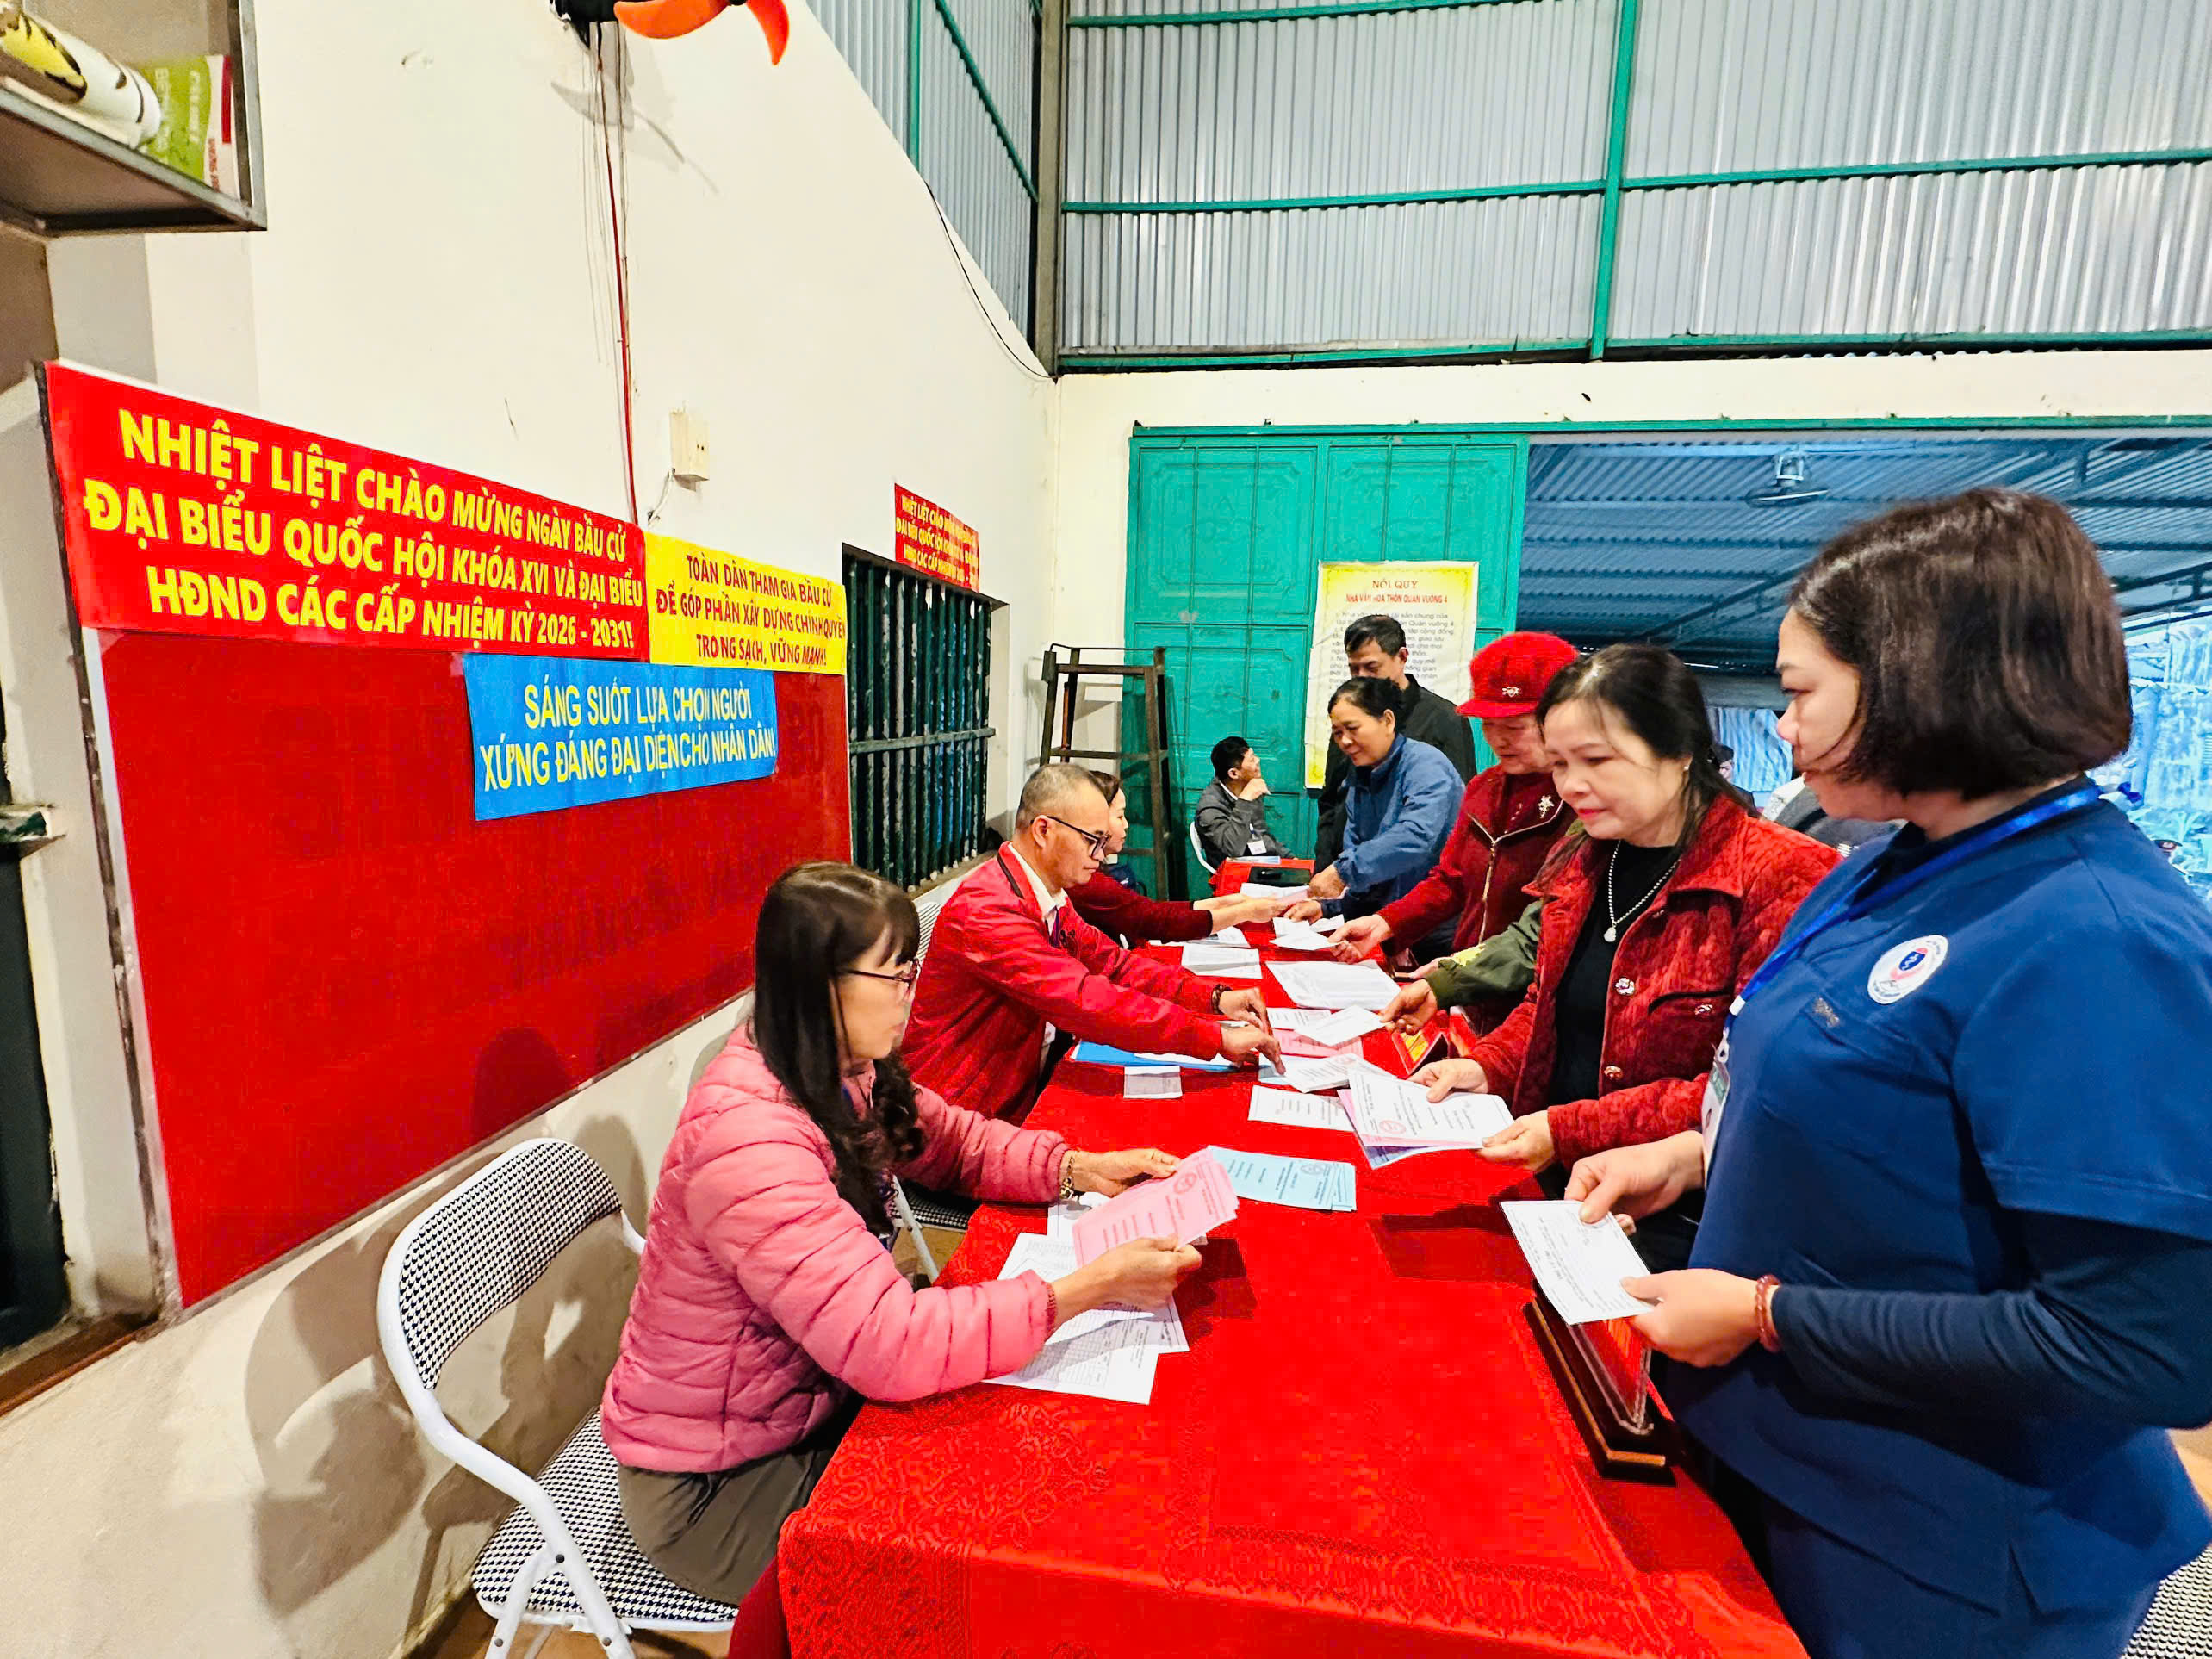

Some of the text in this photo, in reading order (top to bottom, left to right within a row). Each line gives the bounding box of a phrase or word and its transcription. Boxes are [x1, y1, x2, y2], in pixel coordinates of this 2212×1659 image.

[119, 408, 627, 562] NHIỆT LIỆT CHÀO MỪNG NGÀY BẦU CỬ
[83, 477, 643, 610] ĐẠI BIỂU QUỐC HỘI KHÓA XVI VÀ ĐẠI BIỂU
[146, 565, 268, 623] HĐND
[276, 575, 347, 630] CÁC
[355, 582, 416, 634] CẤP
[422, 595, 505, 649] NHIỆM
[510, 600, 535, 643] KỲ
[537, 612, 576, 646] 2026
[591, 618, 635, 649] 2031!
[656, 580, 677, 615] ĐỂ
[680, 587, 701, 618] GÓP
[705, 591, 740, 624] PHẦN
[743, 599, 760, 628] XÂY
[763, 607, 794, 635] DỰNG
[687, 552, 718, 585] TOÀN
[724, 560, 748, 590] DÂN
[749, 570, 780, 598] THAM
[780, 579, 797, 601] GIA
[798, 577, 820, 606] BẦU
[696, 633, 736, 659] TRONG
[738, 637, 767, 666] SẠCH,
[769, 637, 800, 664] VỮNG
[524, 674, 581, 730] SÁNG
[587, 676, 631, 726] SUỐT
[636, 687, 670, 733] LỰA
[711, 680, 753, 722] NGƯỜI
[480, 733, 550, 792] XỨNG
[555, 730, 607, 783] ĐÁNG
[611, 736, 642, 785] ĐẠI
[711, 722, 747, 765] NHÂN
[748, 720, 777, 760] DÂN!
